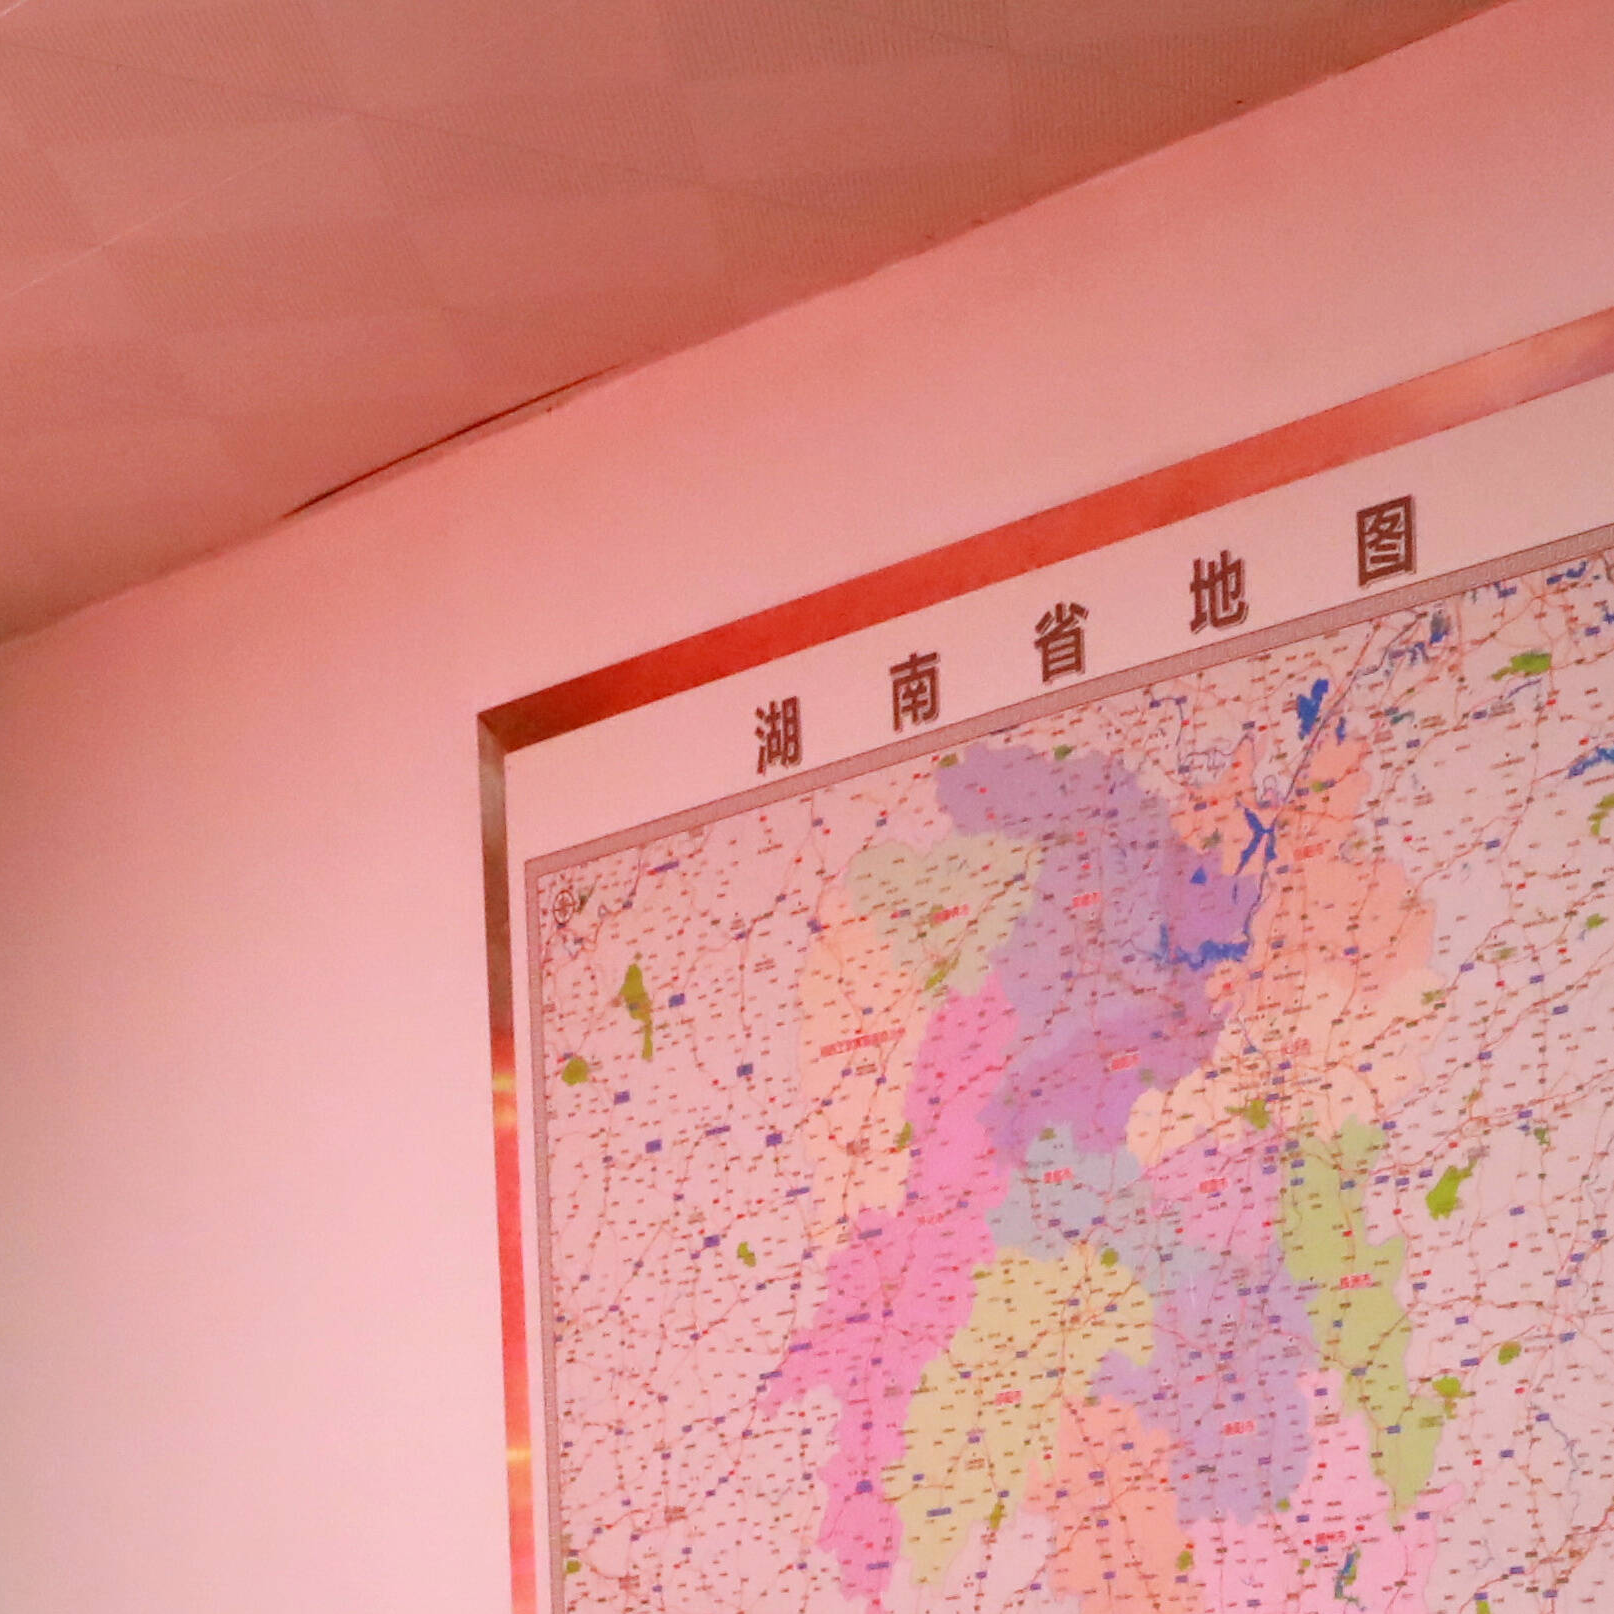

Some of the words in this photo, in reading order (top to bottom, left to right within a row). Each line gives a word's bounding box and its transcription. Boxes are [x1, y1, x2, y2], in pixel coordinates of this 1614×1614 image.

[754, 494, 1418, 774] 湖南省地图
